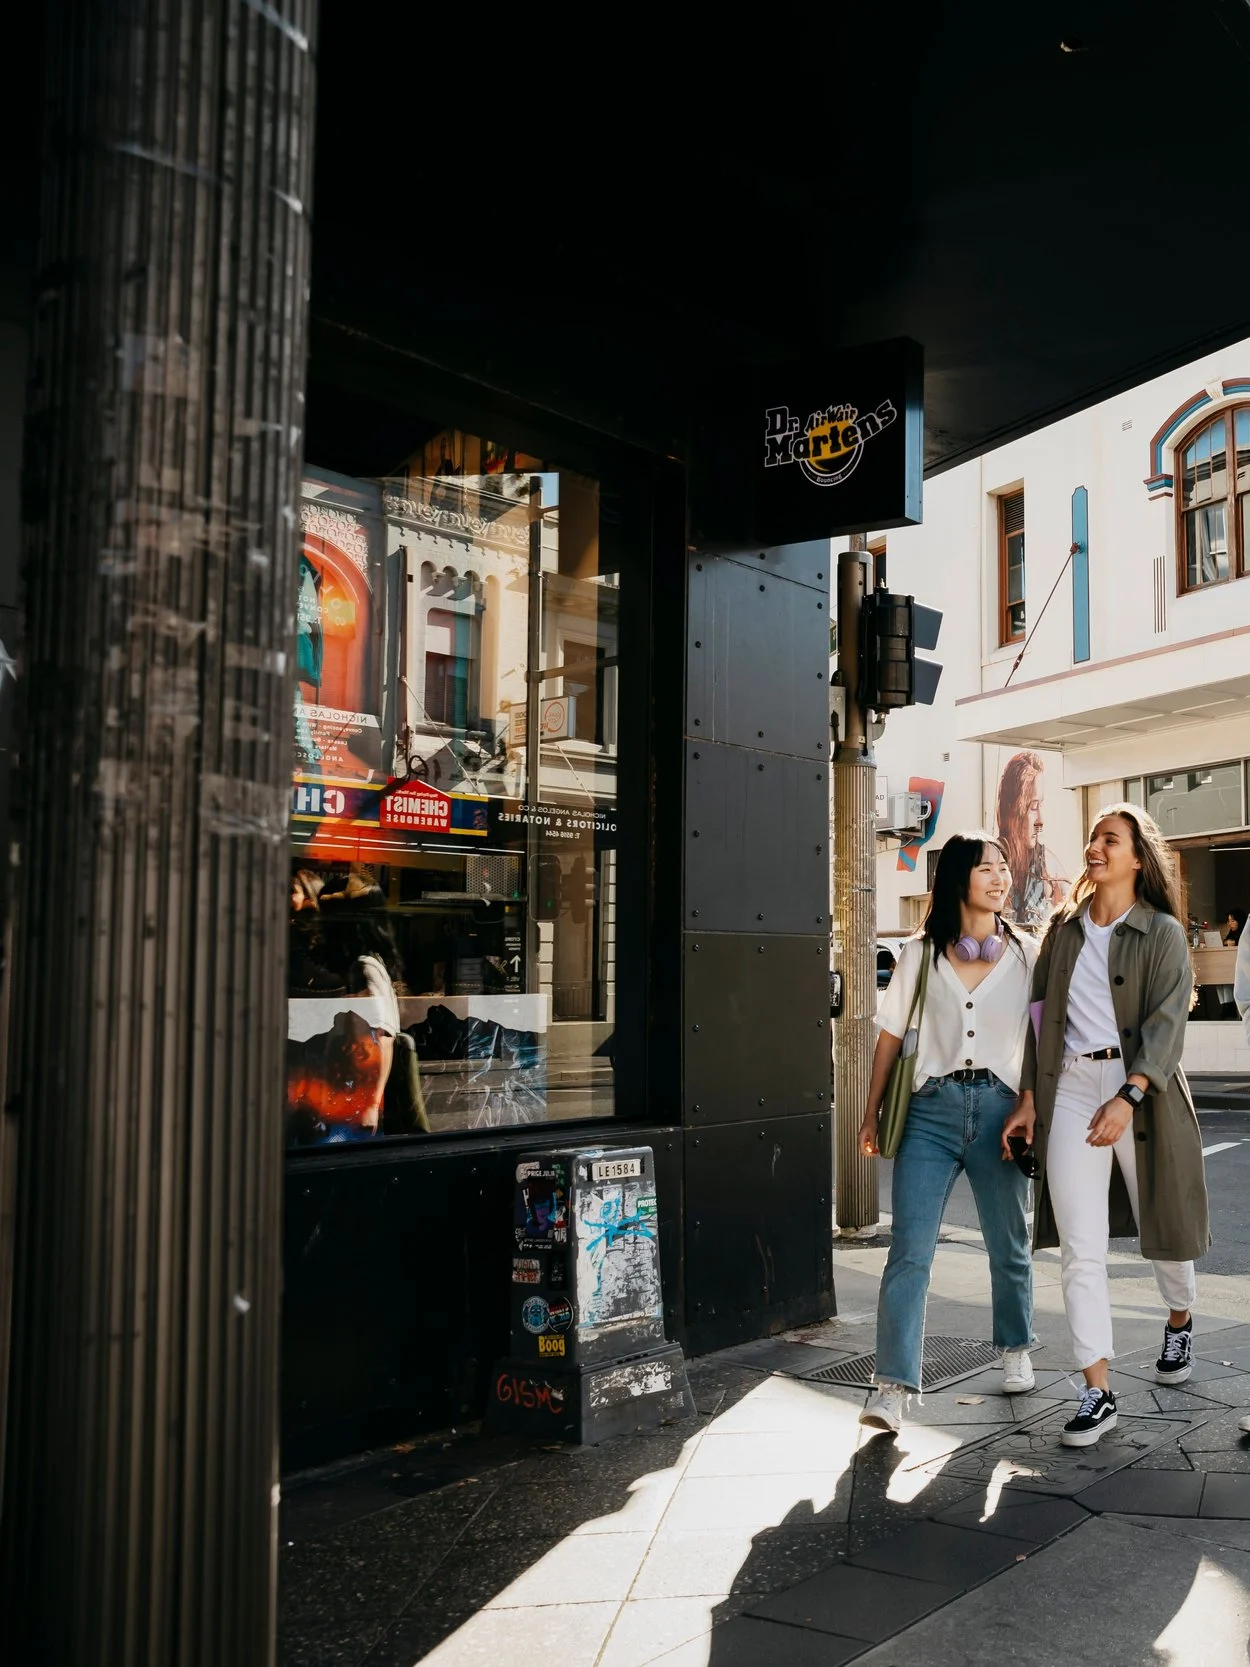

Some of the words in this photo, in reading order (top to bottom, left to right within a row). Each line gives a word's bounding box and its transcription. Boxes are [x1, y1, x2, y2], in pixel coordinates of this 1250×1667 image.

[764, 399, 897, 468] Martens
[765, 406, 800, 437] Dr.
[804, 402, 858, 435] AirWair
[538, 1334, 566, 1356] Boog
